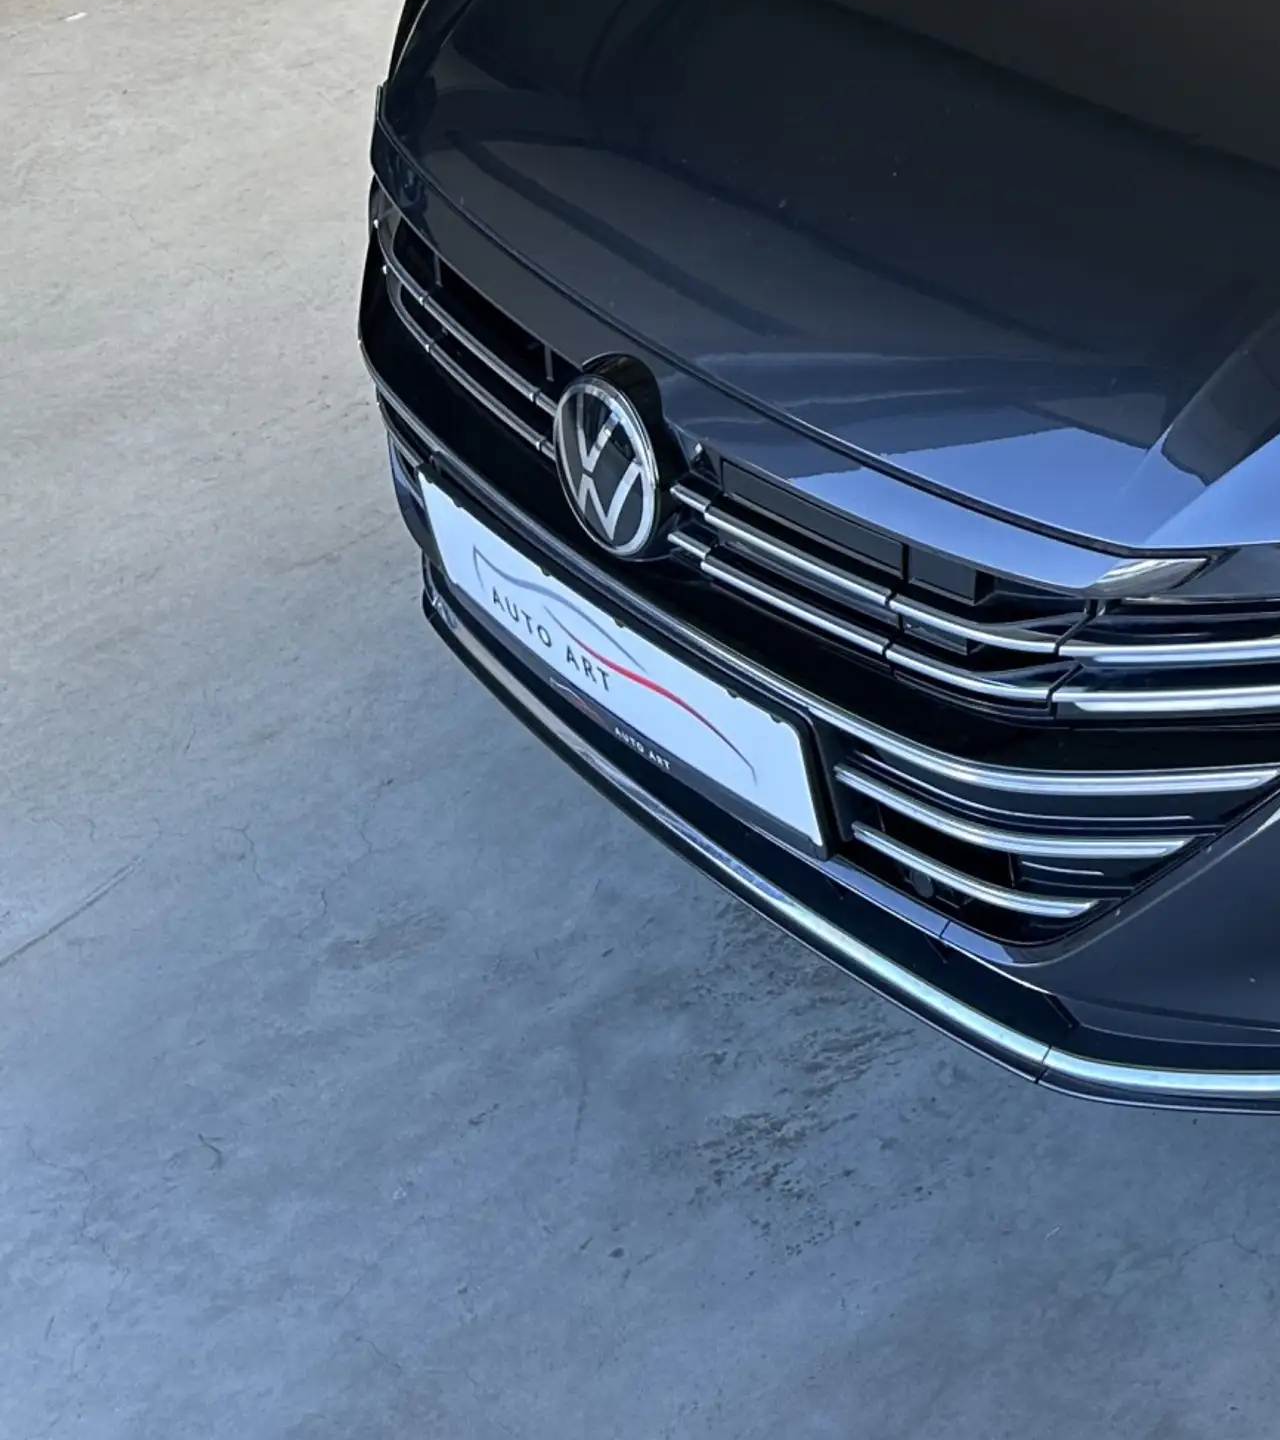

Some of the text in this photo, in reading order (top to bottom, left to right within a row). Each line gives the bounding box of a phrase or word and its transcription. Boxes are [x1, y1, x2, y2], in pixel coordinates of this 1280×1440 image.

[492, 585, 610, 692] AUTO ART
[614, 726, 671, 770] AUTO ART
